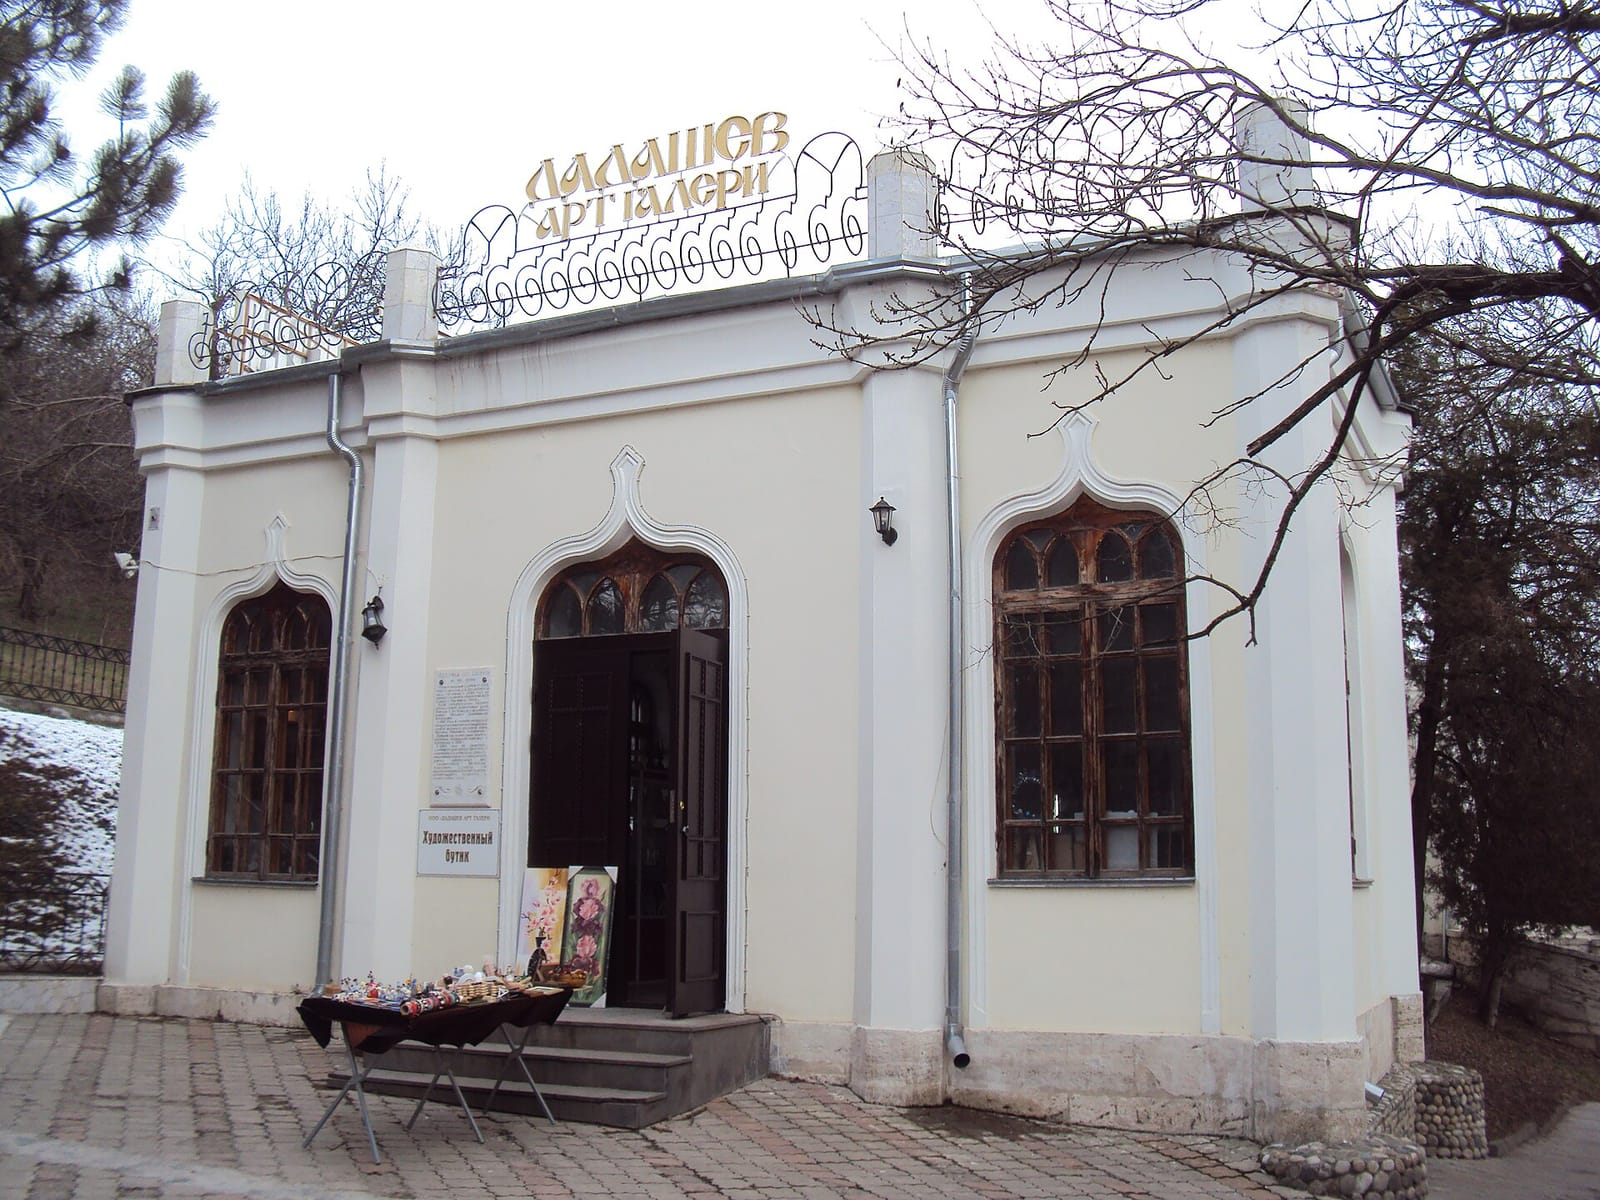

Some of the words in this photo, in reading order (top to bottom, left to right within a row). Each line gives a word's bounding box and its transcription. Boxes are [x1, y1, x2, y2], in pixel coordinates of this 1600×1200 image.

[525, 111, 789, 207] ДАДАШЕВ
[535, 194, 616, 239] АРТ
[622, 161, 769, 222] ГАЛЕРИ
[422, 830, 493, 845] Художественный
[445, 849, 470, 863] бутик
